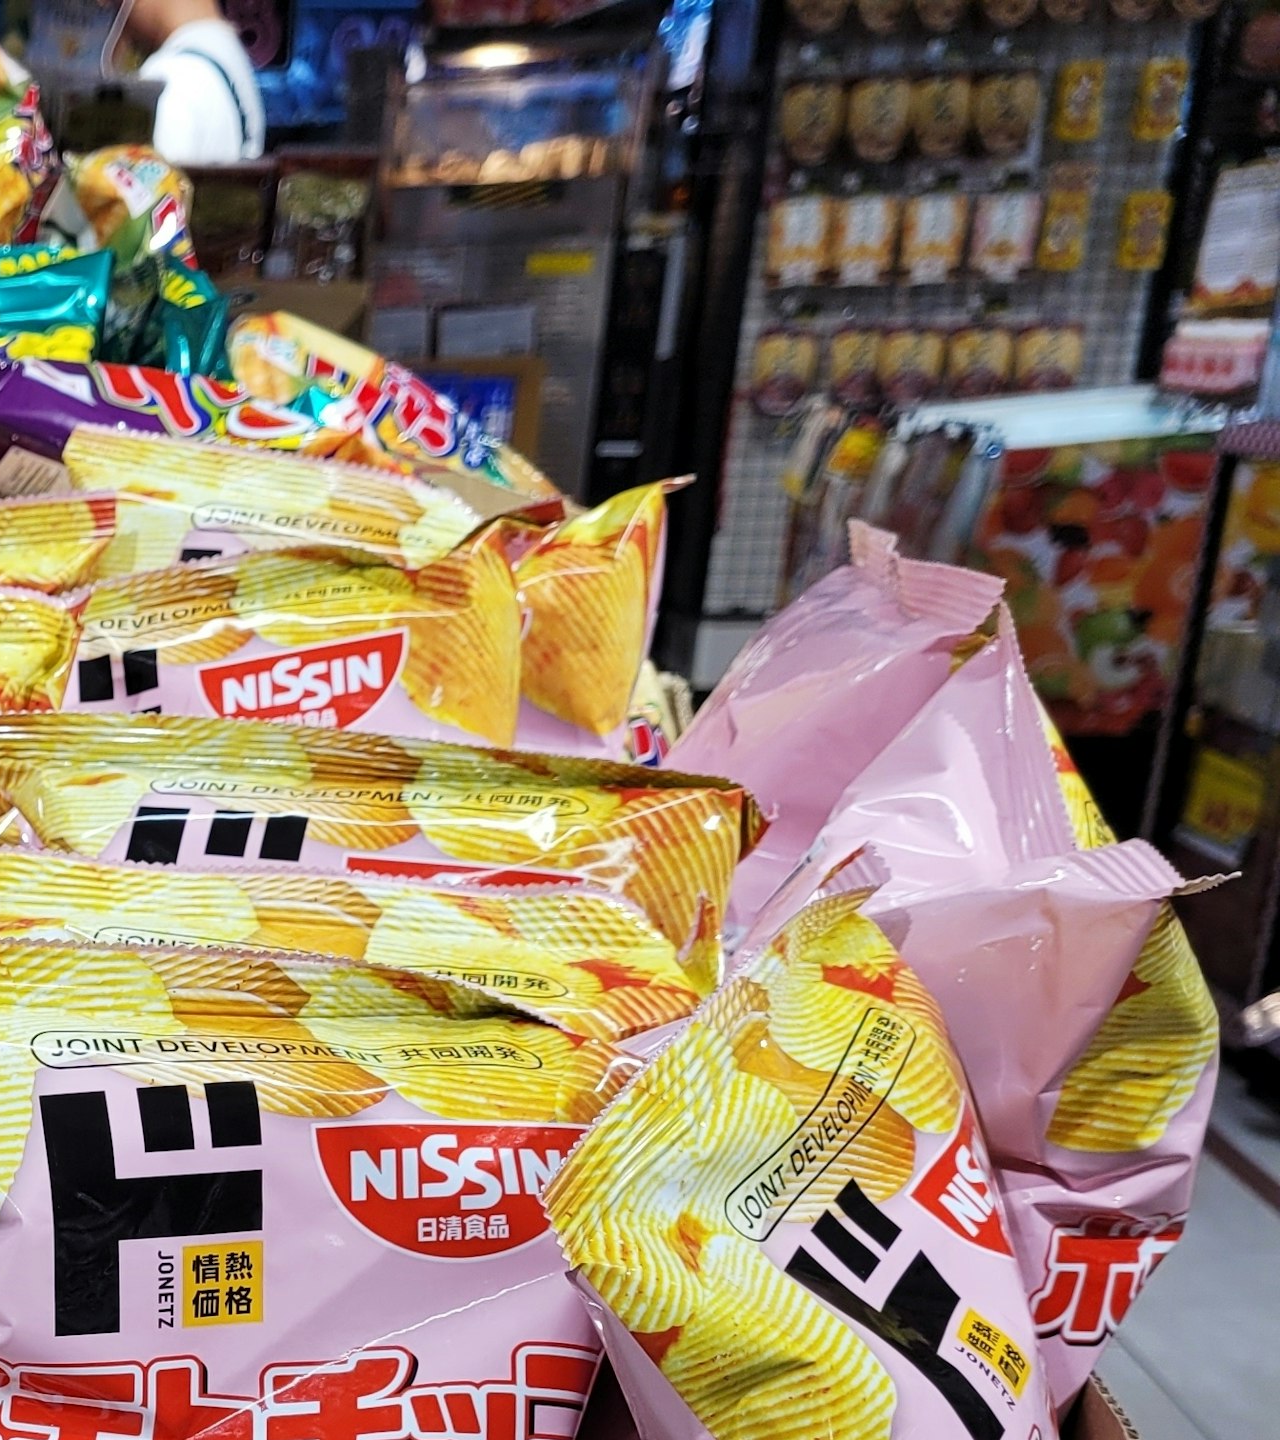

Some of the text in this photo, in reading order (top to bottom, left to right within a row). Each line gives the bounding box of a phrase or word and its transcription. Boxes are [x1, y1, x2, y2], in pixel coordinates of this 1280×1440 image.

[221, 650, 384, 715] NISSIN
[50, 1036, 532, 1067] JOINT DEVELOPMENT 共同開発
[350, 1134, 564, 1211] NISSIN
[415, 1215, 511, 1243] 日清食品
[156, 1250, 174, 1330] JONETZ
[954, 1345, 1017, 1412] JONETZ
